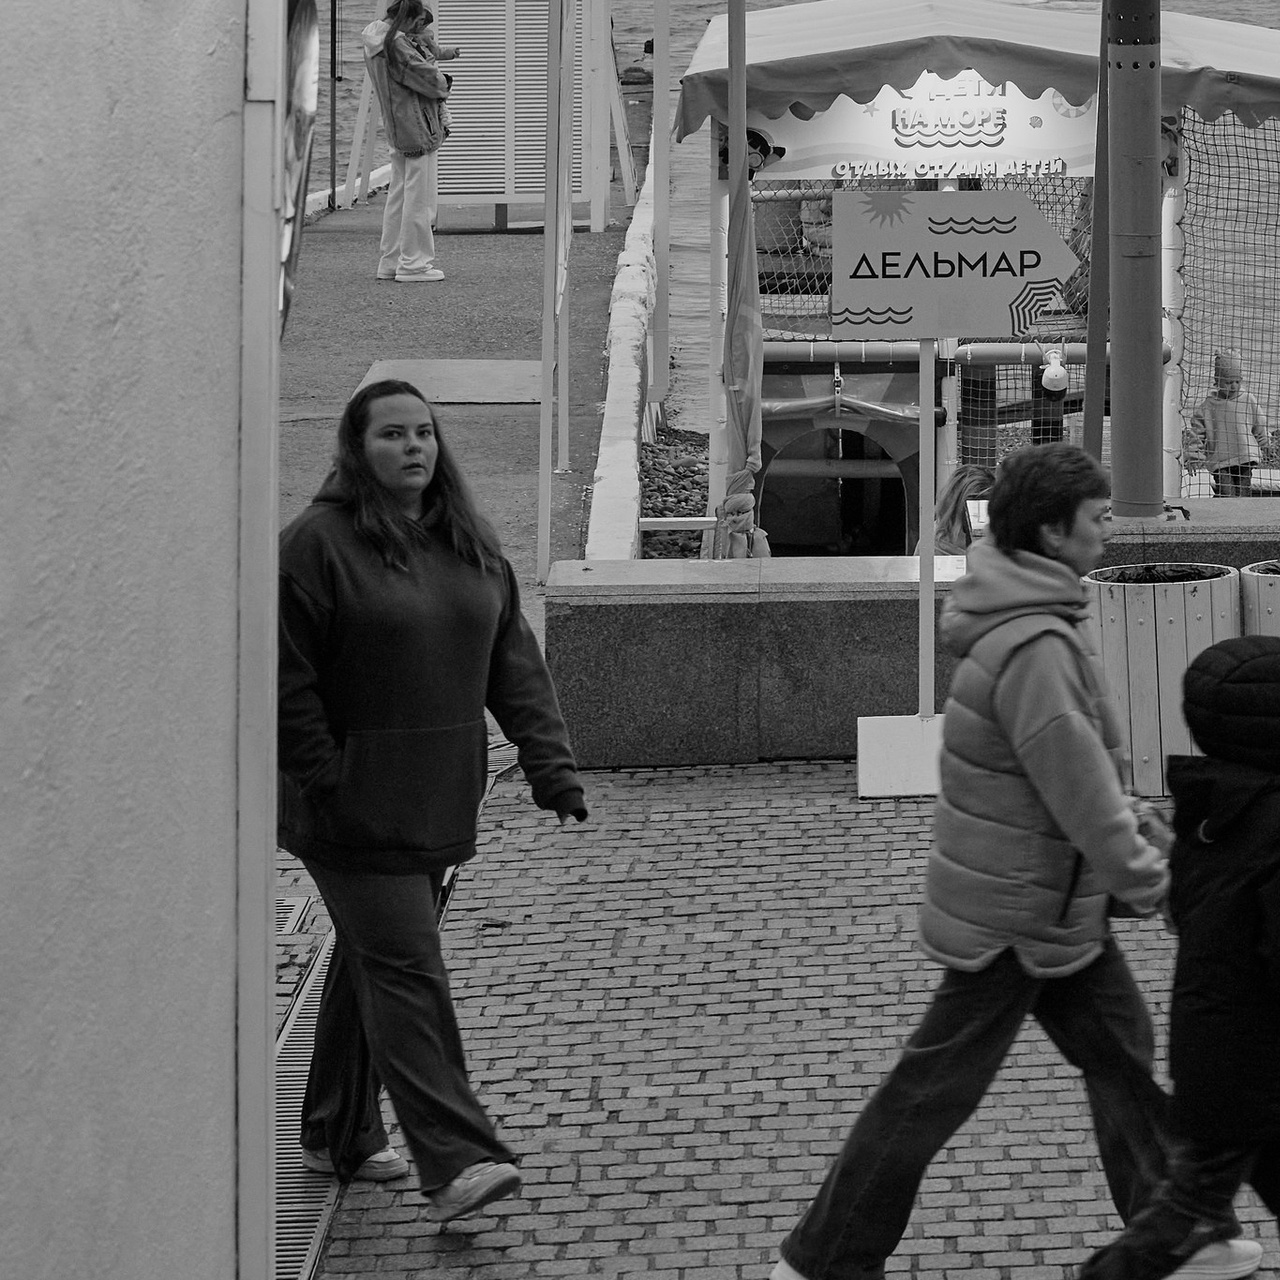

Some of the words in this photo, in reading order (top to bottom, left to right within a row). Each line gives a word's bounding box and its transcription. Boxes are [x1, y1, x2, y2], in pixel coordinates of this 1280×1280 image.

[892, 108, 929, 129] НА
[933, 108, 1007, 129] МОРЕ
[832, 160, 909, 178] ОТДЫХ
[1003, 156, 1067, 178] ДЕТЕЙ
[849, 250, 1042, 279] ДЕЛЬМАР
